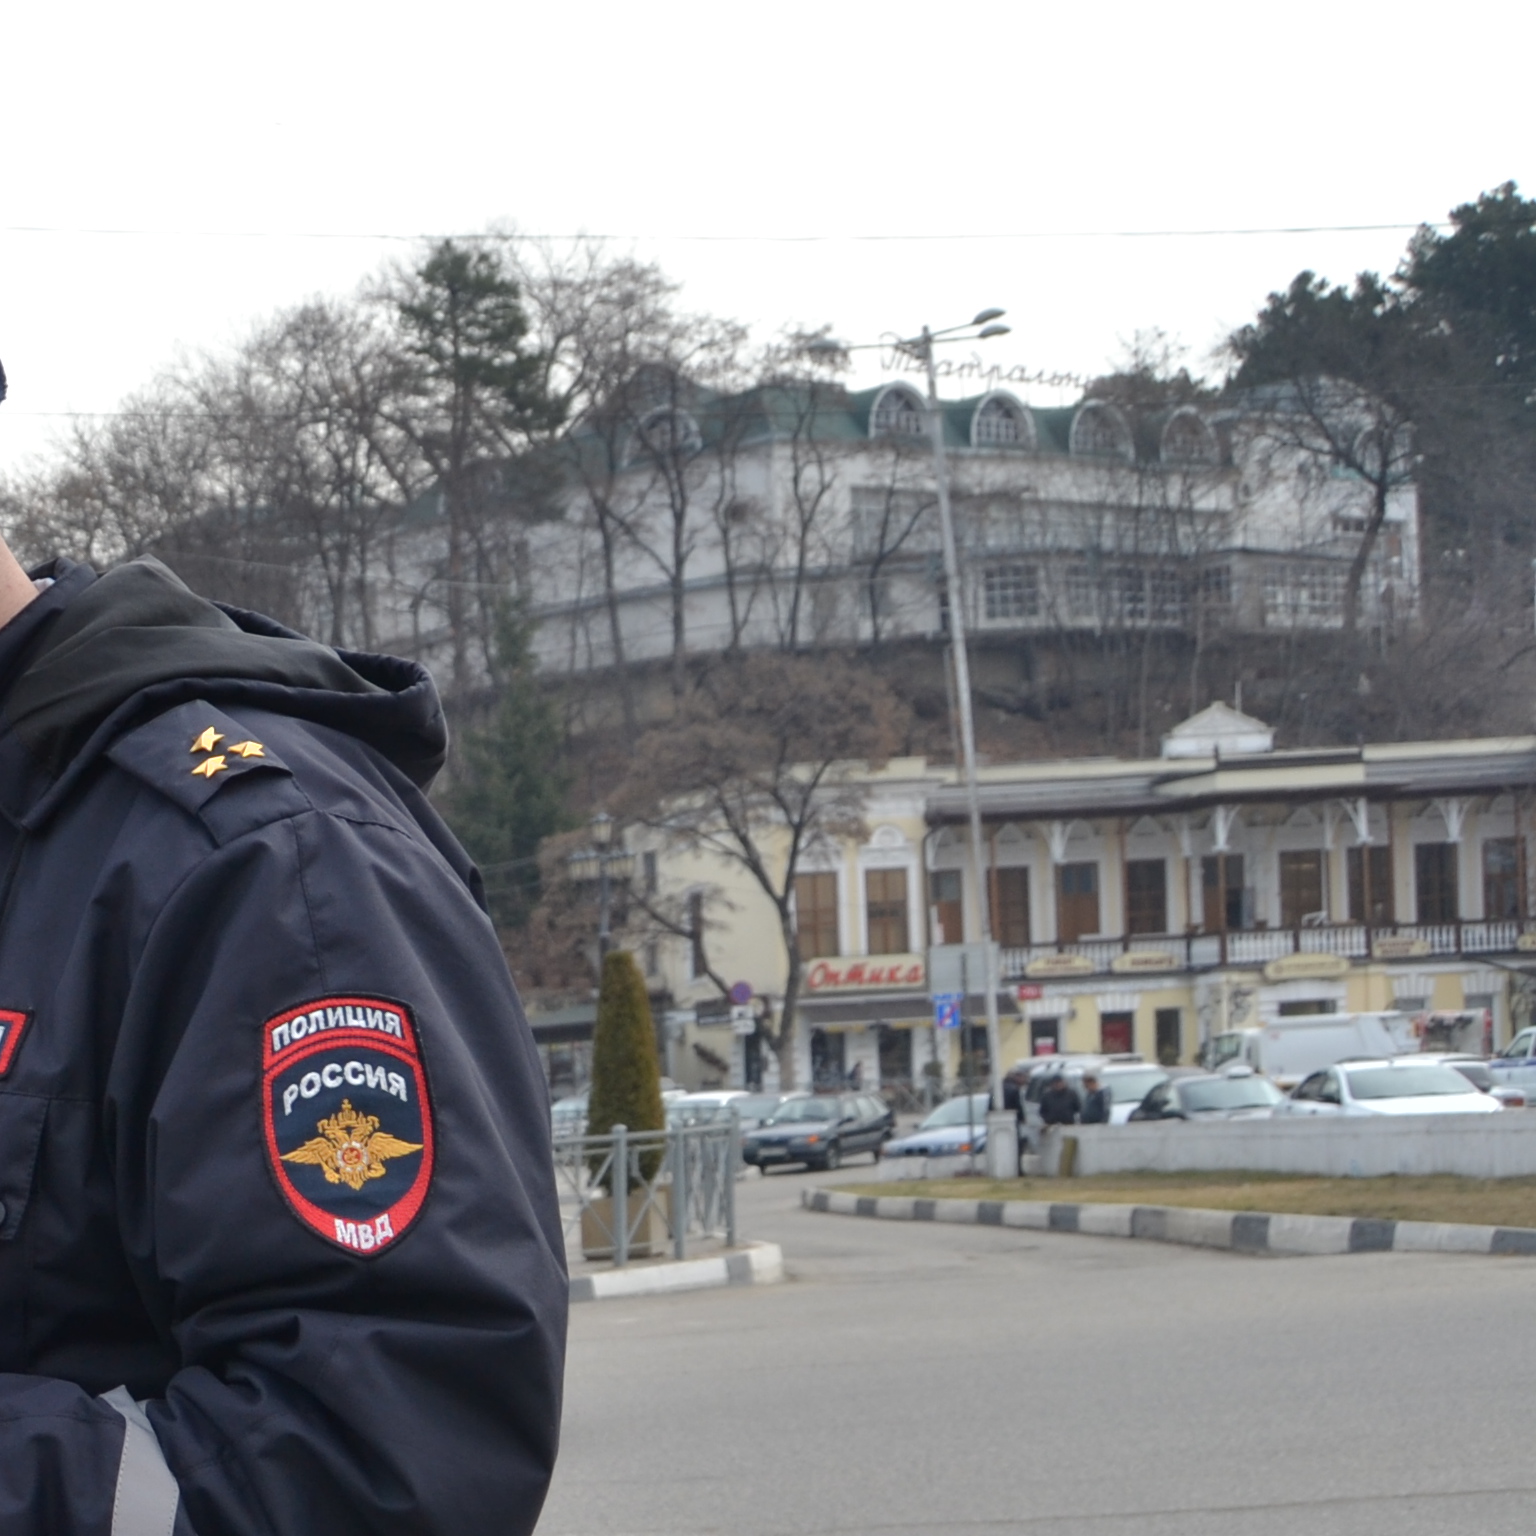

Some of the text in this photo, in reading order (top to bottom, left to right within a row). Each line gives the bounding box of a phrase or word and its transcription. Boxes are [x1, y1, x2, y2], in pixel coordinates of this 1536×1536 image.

[808, 960, 923, 989] Оптика
[271, 1005, 403, 1051] ПОЛИЦИЯ
[283, 1061, 408, 1116] РОССИЯ
[334, 1213, 394, 1250] МВД
